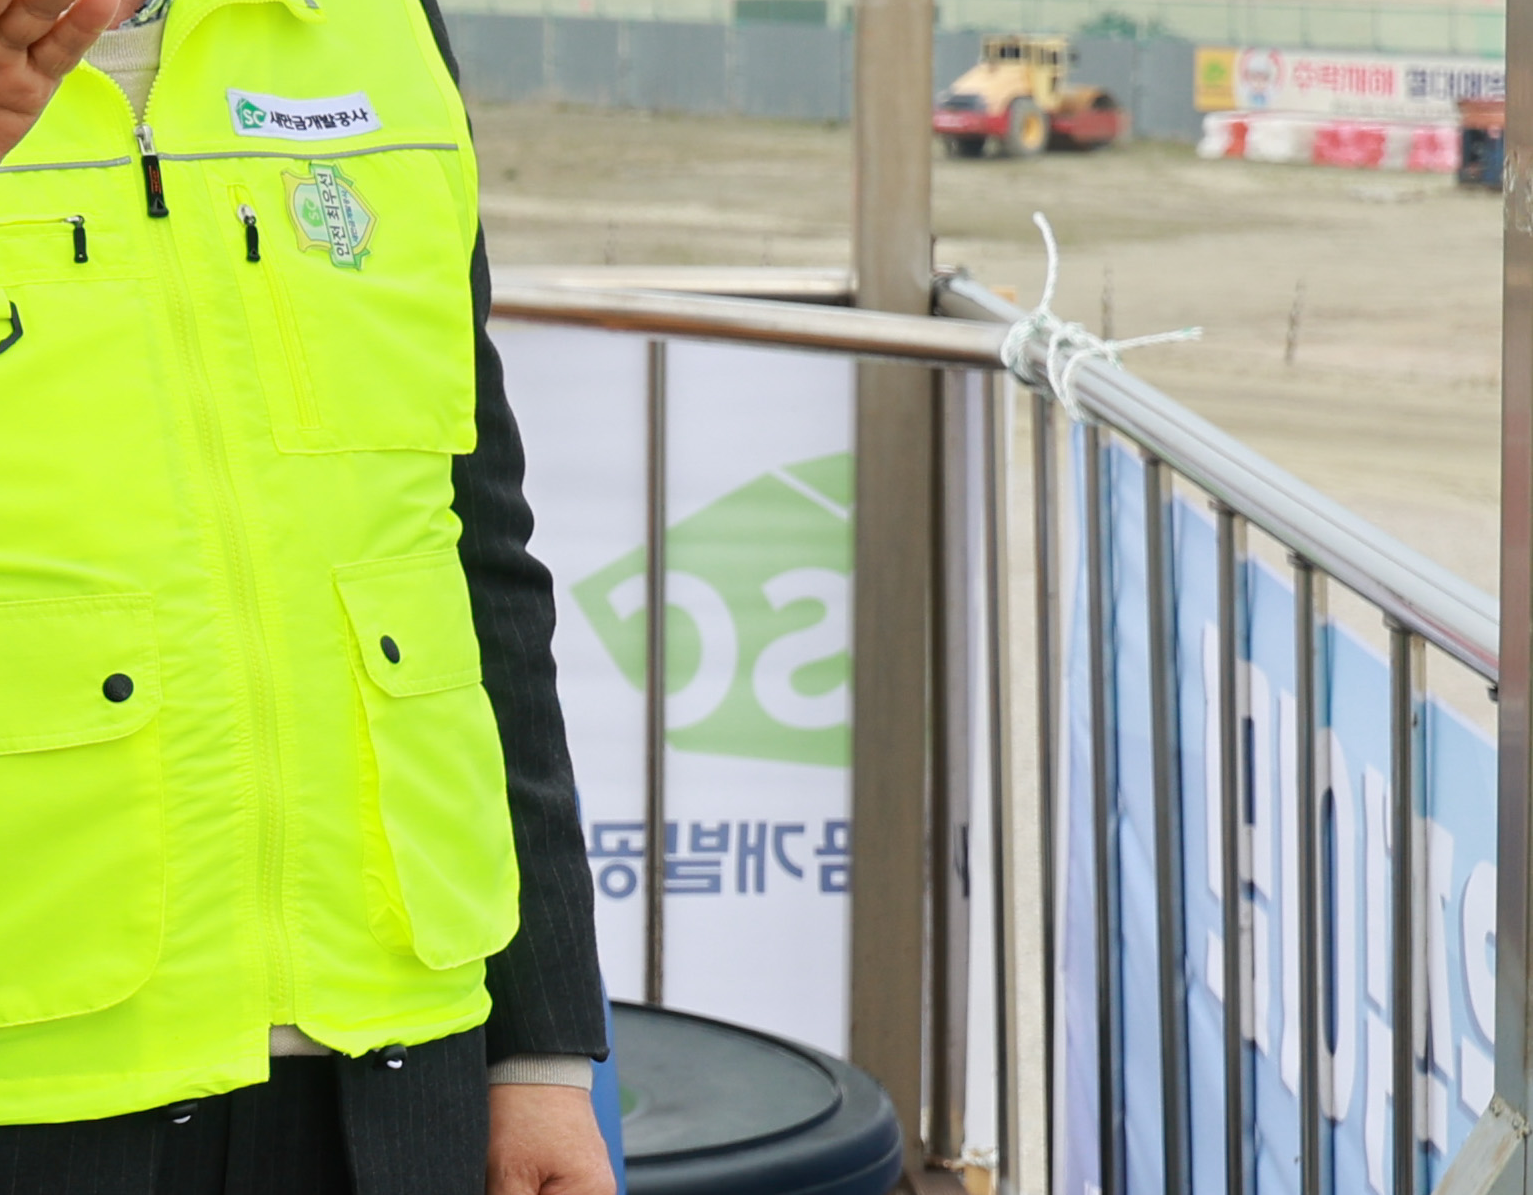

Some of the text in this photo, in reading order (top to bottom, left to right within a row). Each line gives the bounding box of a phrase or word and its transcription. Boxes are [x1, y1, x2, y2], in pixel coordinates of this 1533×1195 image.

[242, 107, 369, 131] SC 새만금개발공사
[317, 172, 351, 257] 안전 최우선
